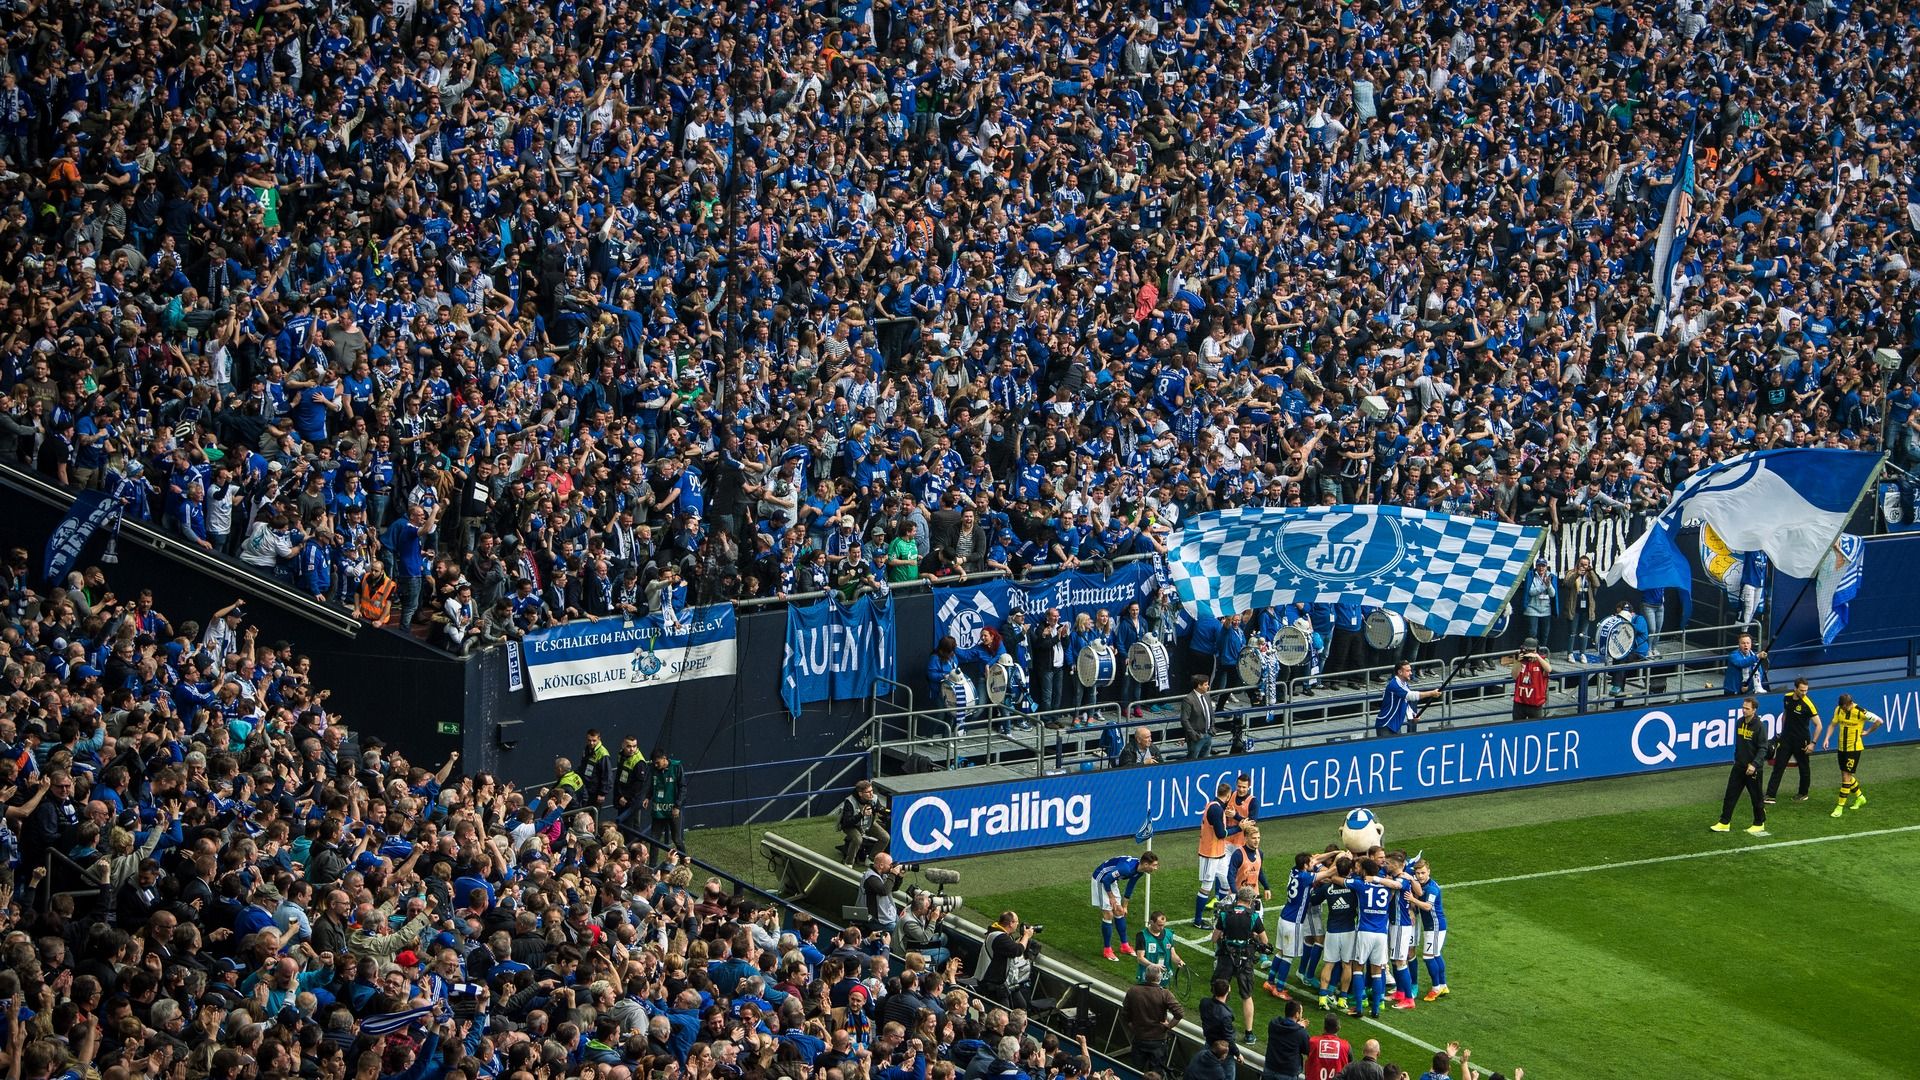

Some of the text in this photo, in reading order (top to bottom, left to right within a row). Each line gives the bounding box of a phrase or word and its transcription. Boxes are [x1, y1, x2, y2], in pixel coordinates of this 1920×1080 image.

[260, 189, 270, 206] 4
[295, 326, 305, 346] 7
[1158, 378, 1168, 393] 8
[1053, 577, 1135, 610] Hammers
[535, 641, 549, 653] FC
[550, 634, 599, 651] SCHALKE
[600, 632, 613, 644] 04
[614, 627, 661, 643] FANCLUB
[1518, 686, 1534, 699] TV
[902, 790, 1092, 854] Q-railing
[1417, 732, 1580, 787] GELÄNDER
[1364, 888, 1389, 908] 13
[1426, 942, 1433, 952] 7
